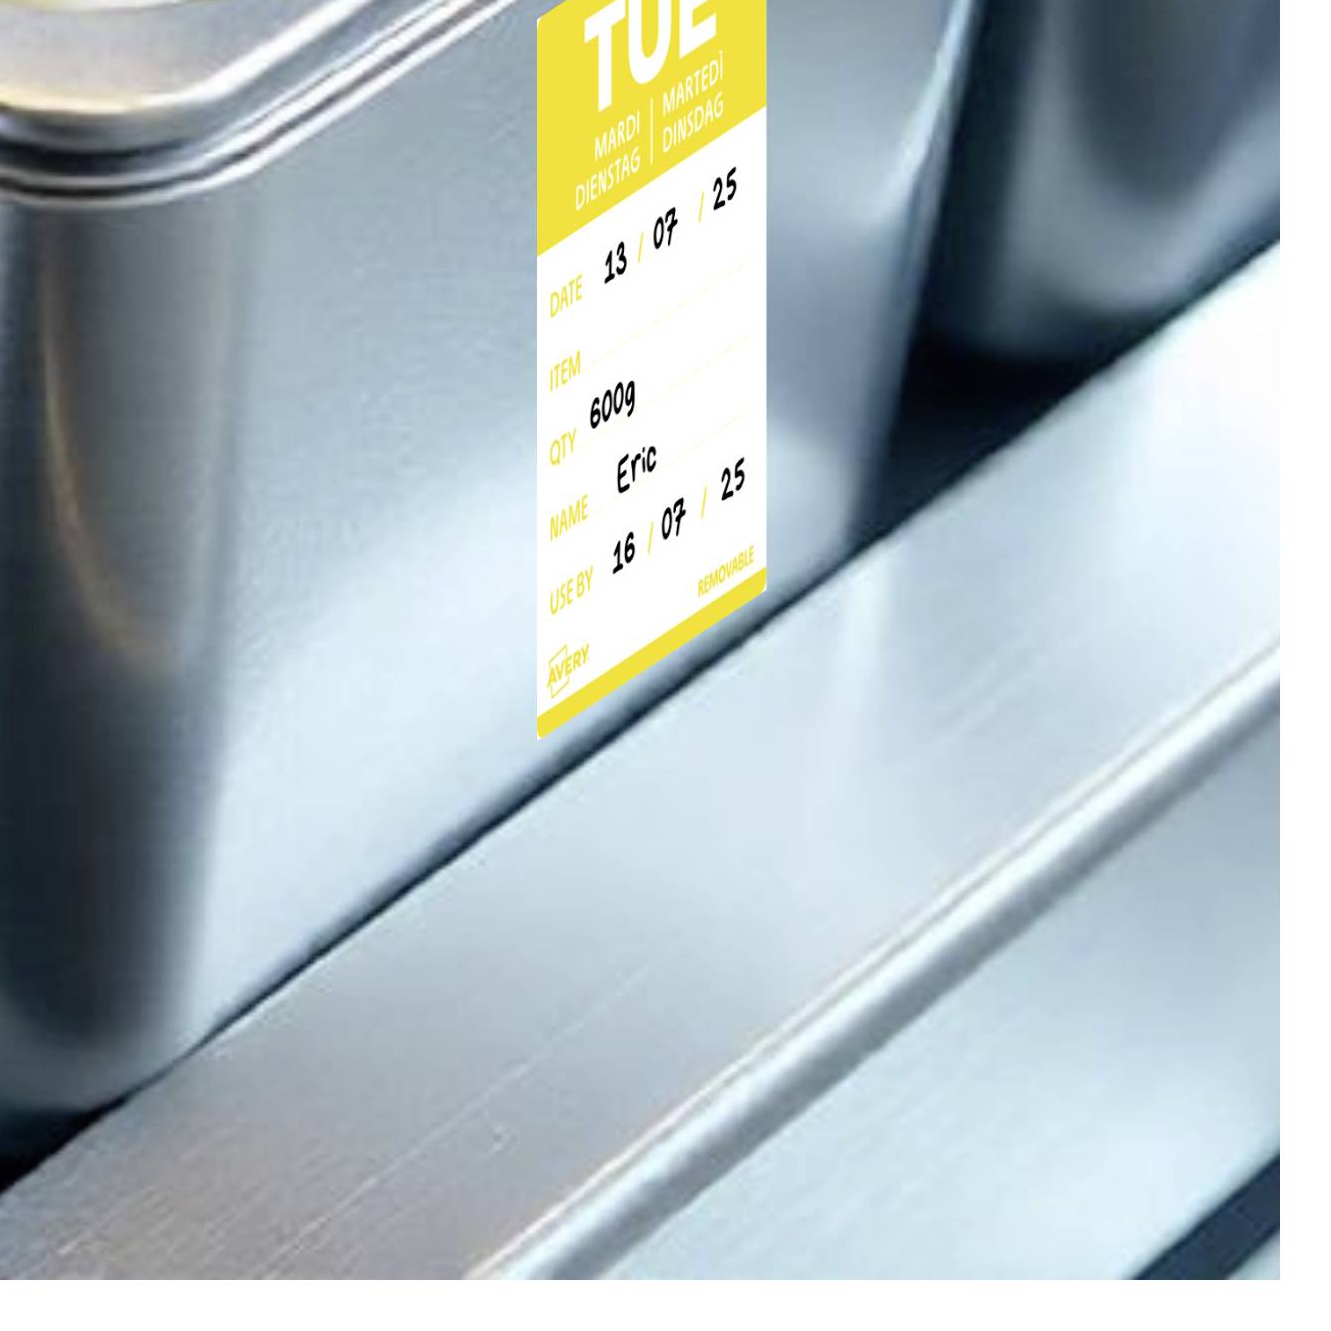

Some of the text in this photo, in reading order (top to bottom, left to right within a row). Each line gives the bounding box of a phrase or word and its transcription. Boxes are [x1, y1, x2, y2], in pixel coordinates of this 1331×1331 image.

[662, 50, 723, 116] MARTEDÌ
[595, 109, 640, 163] MARDI
[662, 92, 724, 154] DINSDAG
[575, 147, 640, 211] DIENSTAG
[604, 241, 627, 284] 13
[653, 207, 678, 250] 07
[713, 167, 737, 211] 25
[550, 274, 583, 318] DATE
[549, 350, 581, 392] ITEM
[590, 380, 635, 429] 600g
[549, 427, 577, 466] QTY
[617, 446, 657, 494] Eric
[550, 494, 589, 542] NAME
[613, 531, 636, 574] 16
[661, 497, 687, 540] 07
[721, 457, 745, 501] 25
[549, 565, 594, 615] USE BY
[697, 545, 755, 597] REMOVABLE
[547, 643, 590, 688] AVERY
